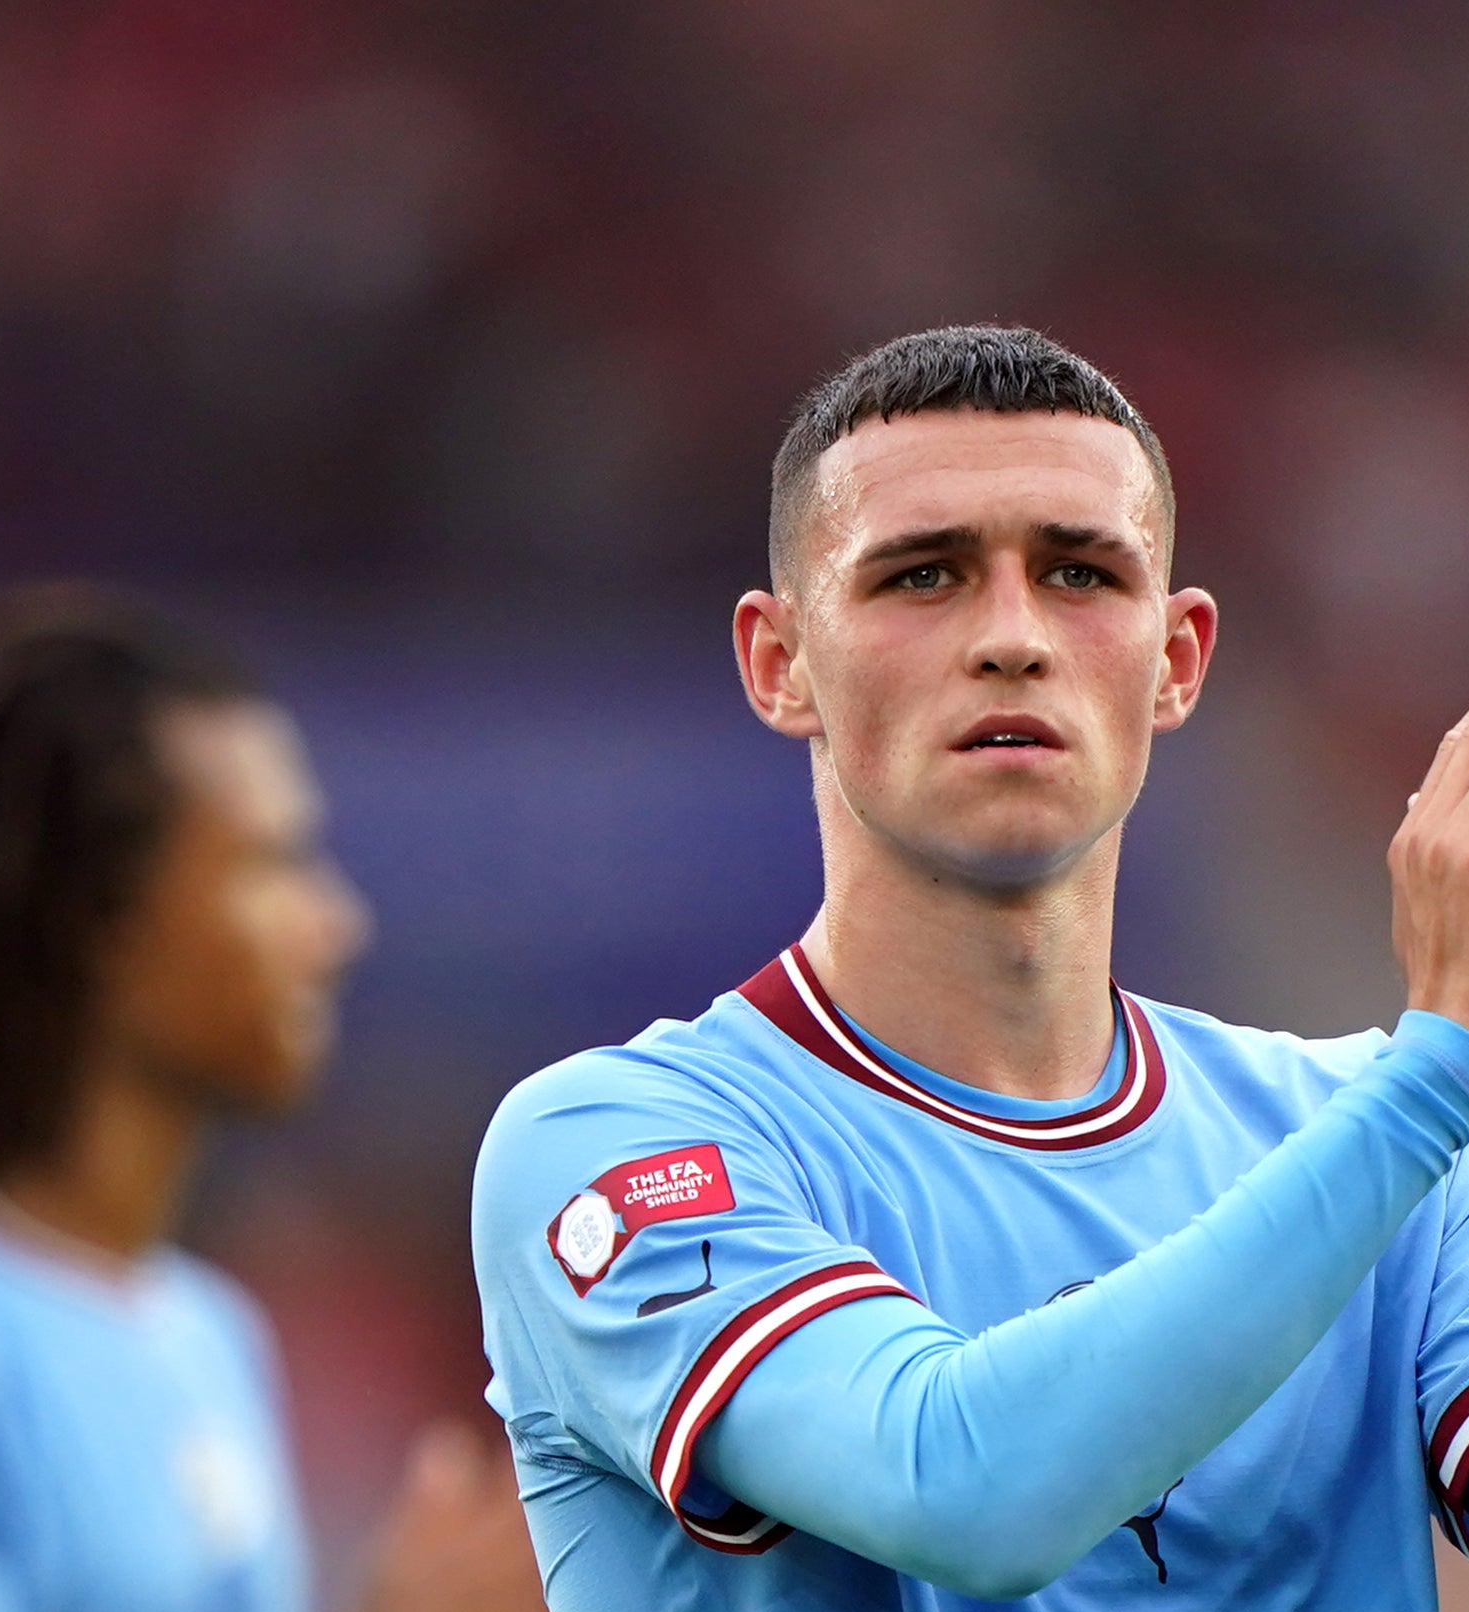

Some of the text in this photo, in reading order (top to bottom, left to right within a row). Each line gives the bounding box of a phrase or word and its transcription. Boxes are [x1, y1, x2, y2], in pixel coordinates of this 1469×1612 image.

[624, 1173, 713, 1205] COMMUNITY
[627, 1160, 703, 1189] THE FA
[645, 1188, 699, 1209] SHIELD
